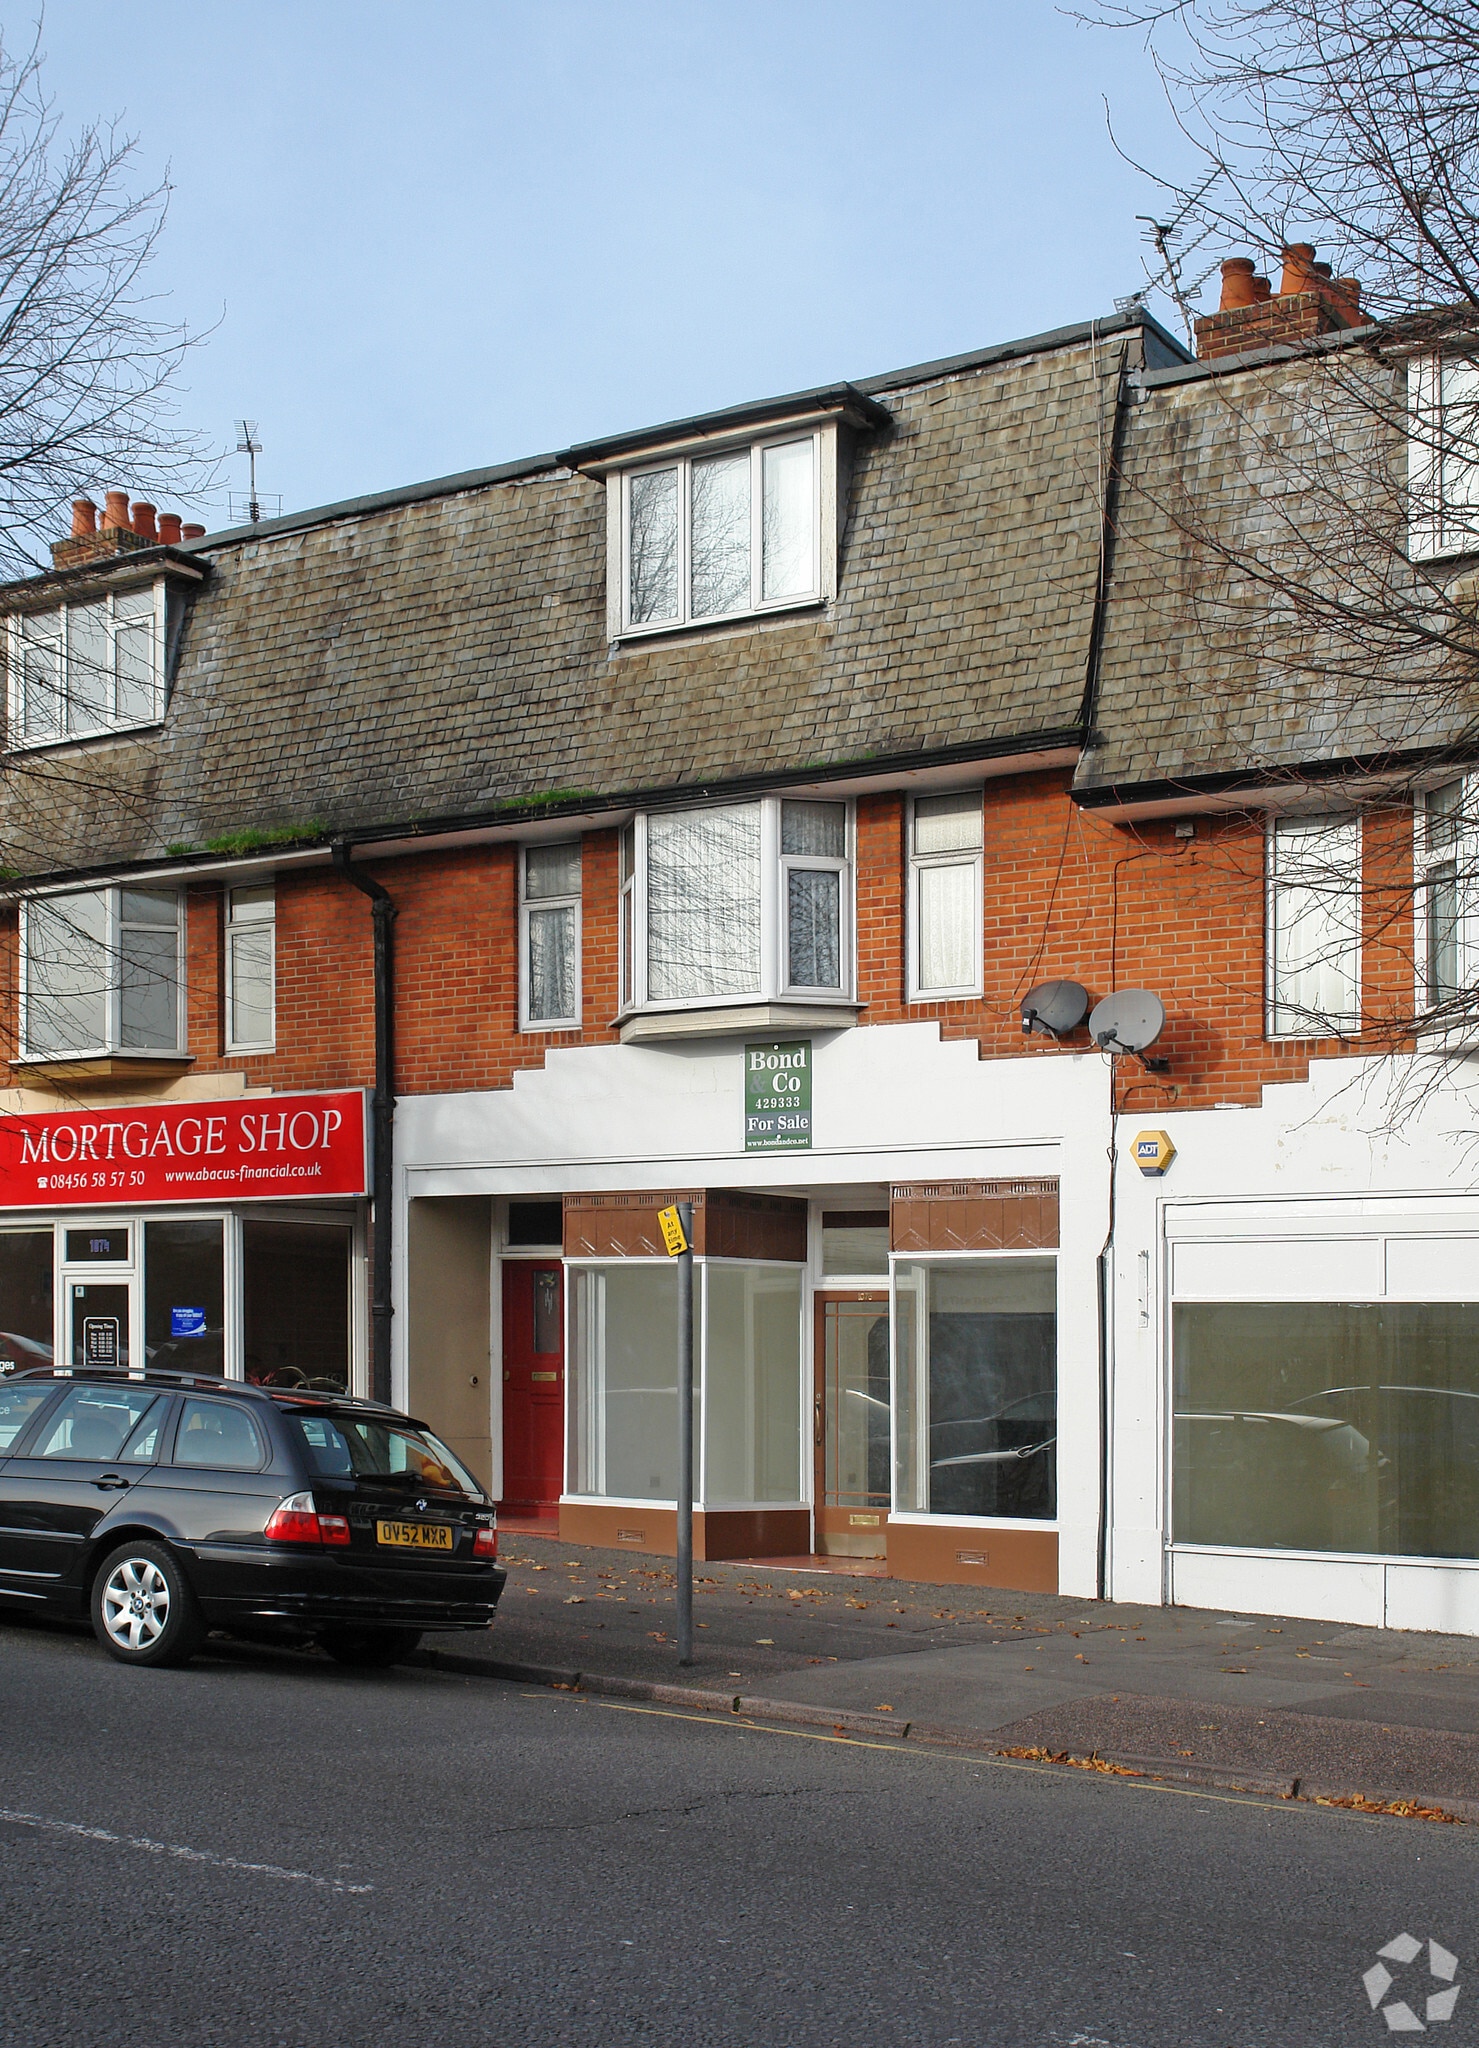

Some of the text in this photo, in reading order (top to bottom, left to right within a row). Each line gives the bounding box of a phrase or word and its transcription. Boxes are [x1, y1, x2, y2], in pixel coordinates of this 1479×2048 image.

[749, 1047, 806, 1070] Bond
[750, 1072, 801, 1094] & Co
[755, 1097, 800, 1109] 429333
[747, 1115, 809, 1131] For Sale
[20, 1109, 342, 1164] MORTGAGE SHOP
[1138, 1144, 1158, 1154] ADT
[51, 1170, 145, 1189] 08456 58 57 50
[165, 1162, 322, 1182] www.abacus-financial.co.uk
[383, 1524, 446, 1545] OV52 MXR
